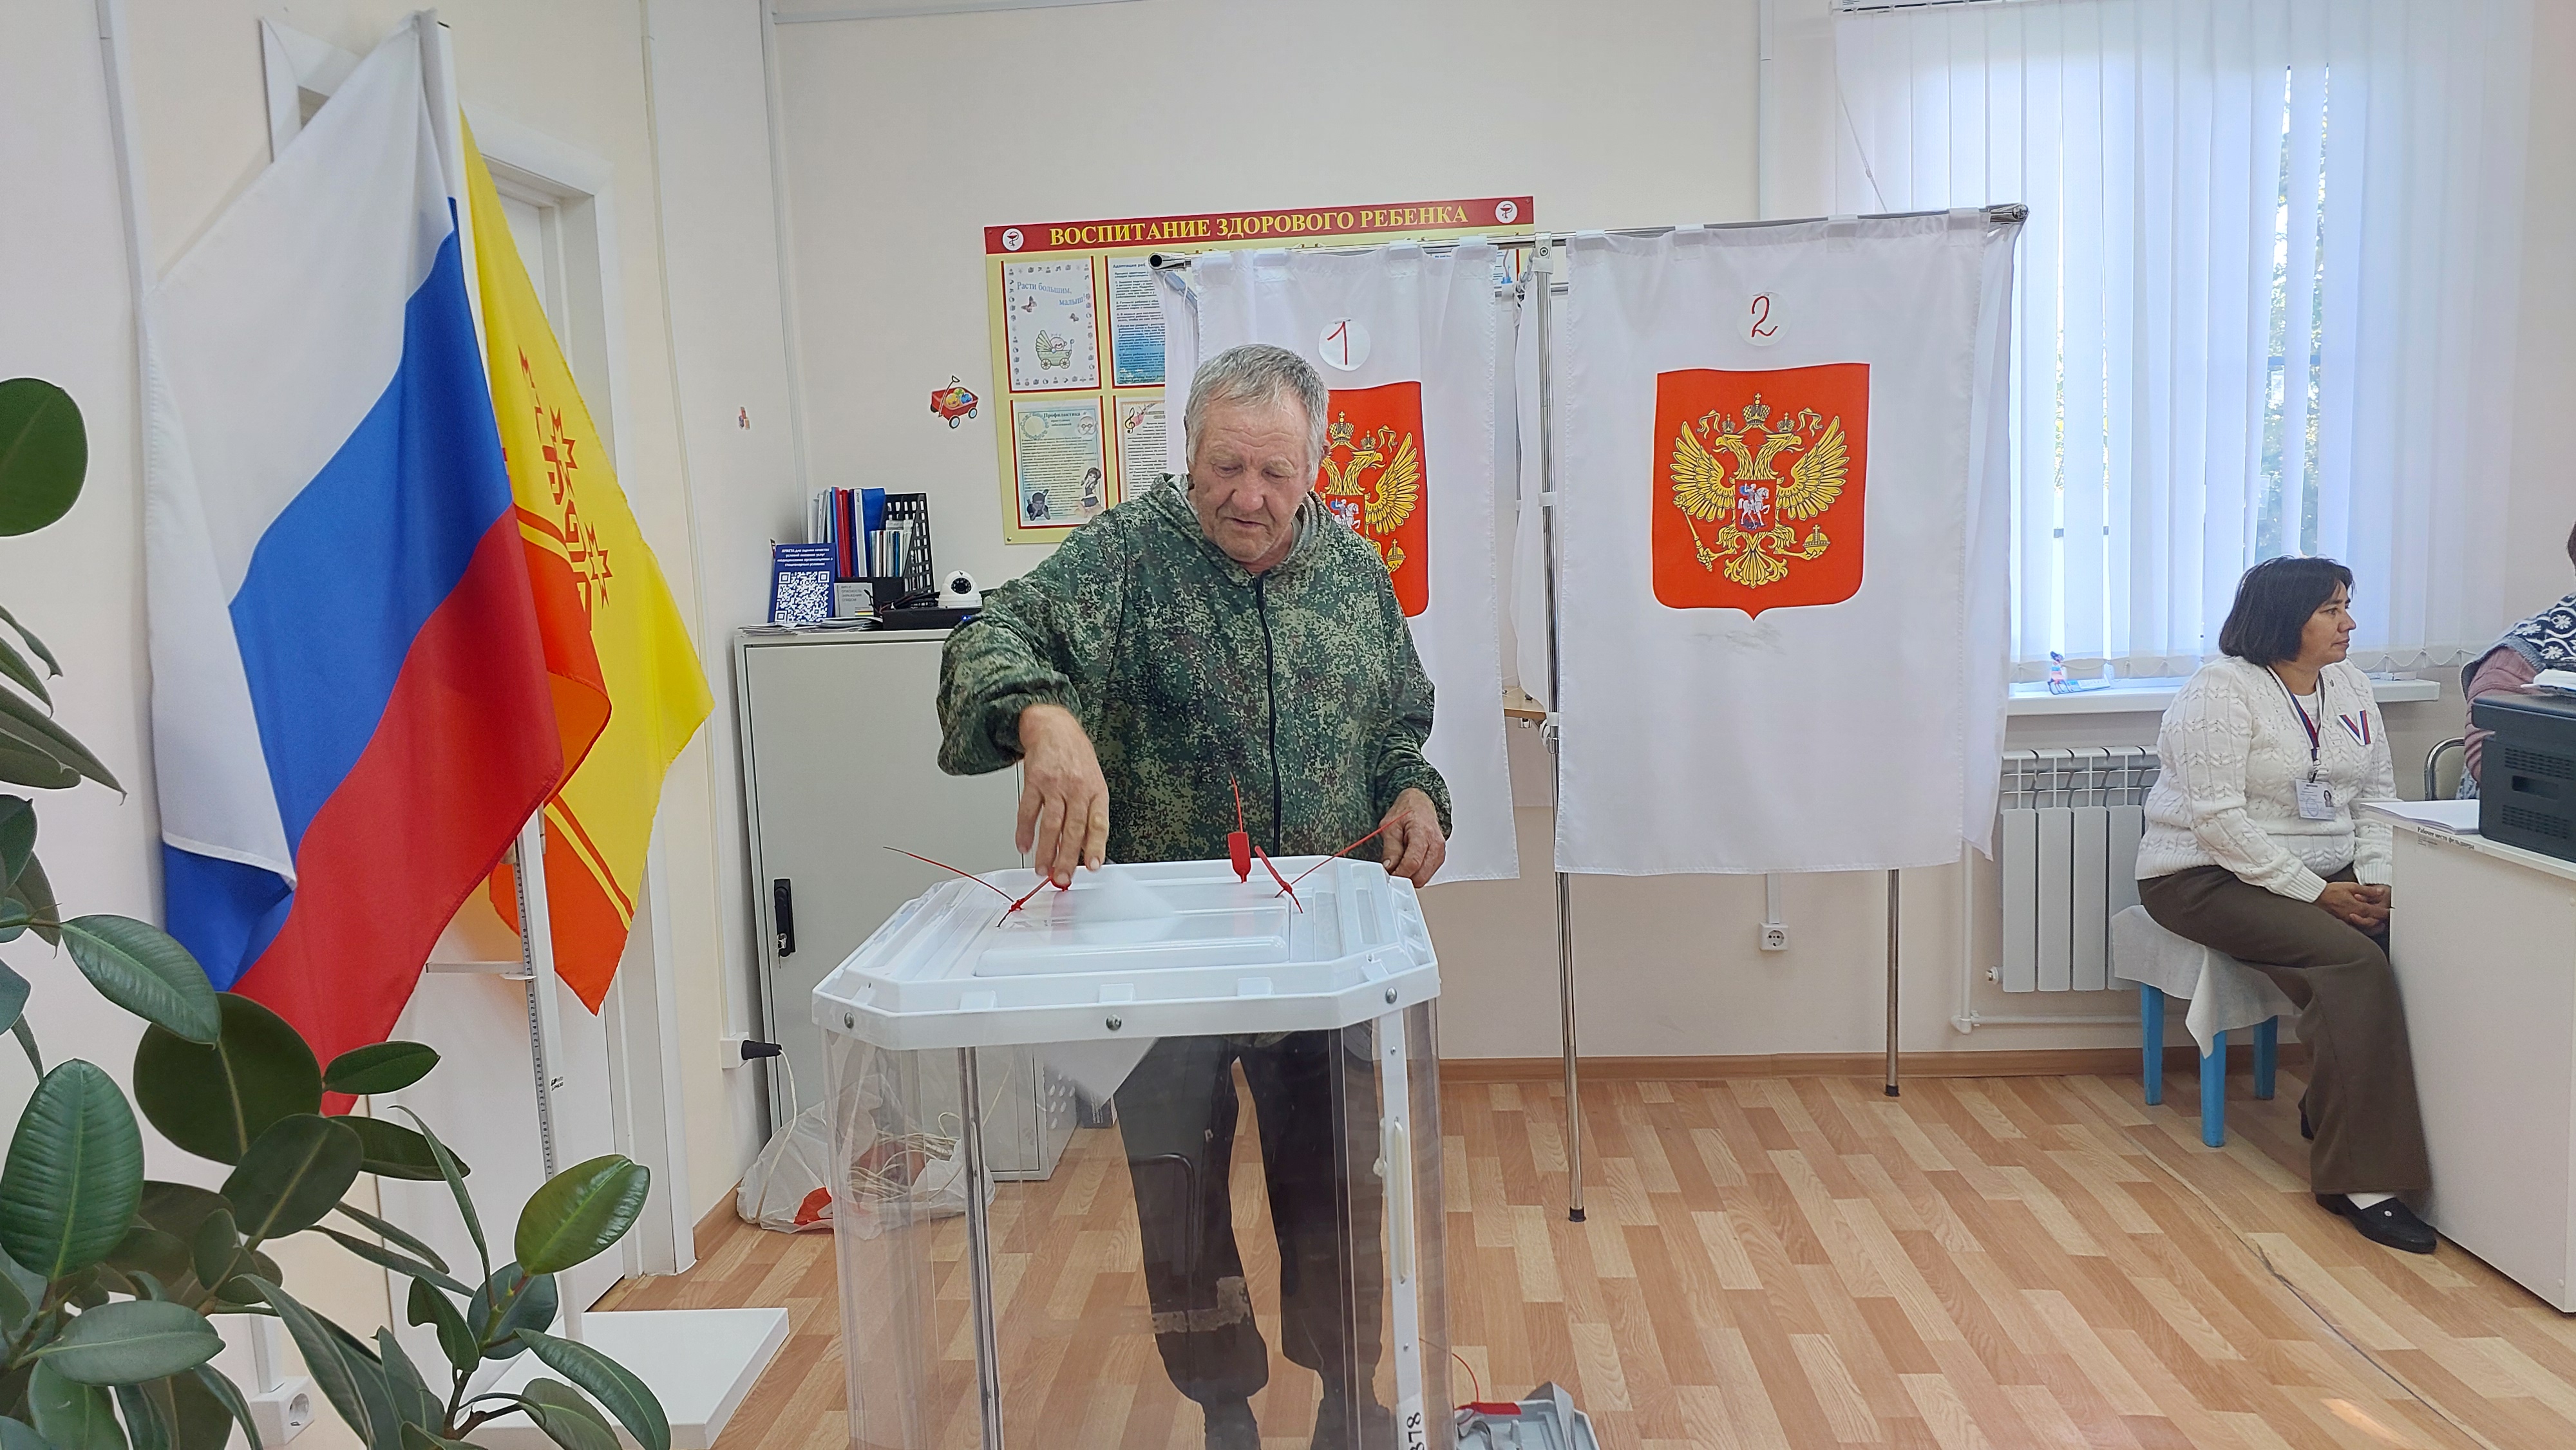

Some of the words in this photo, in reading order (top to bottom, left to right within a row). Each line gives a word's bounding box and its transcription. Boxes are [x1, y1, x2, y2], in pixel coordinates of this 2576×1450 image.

[1049, 220, 1211, 246] ВОСПИТАНИЕ
[1217, 211, 1354, 239] ЗДОРОВОГО
[1359, 205, 1468, 229] РЕБЕНКА
[1017, 281, 1037, 290] Расти
[1038, 283, 1072, 294] большим,
[1059, 293, 1086, 306] малыш!
[1751, 296, 1779, 337] 2
[1327, 321, 1347, 366] 1
[2417, 825, 2434, 836] Рабочее
